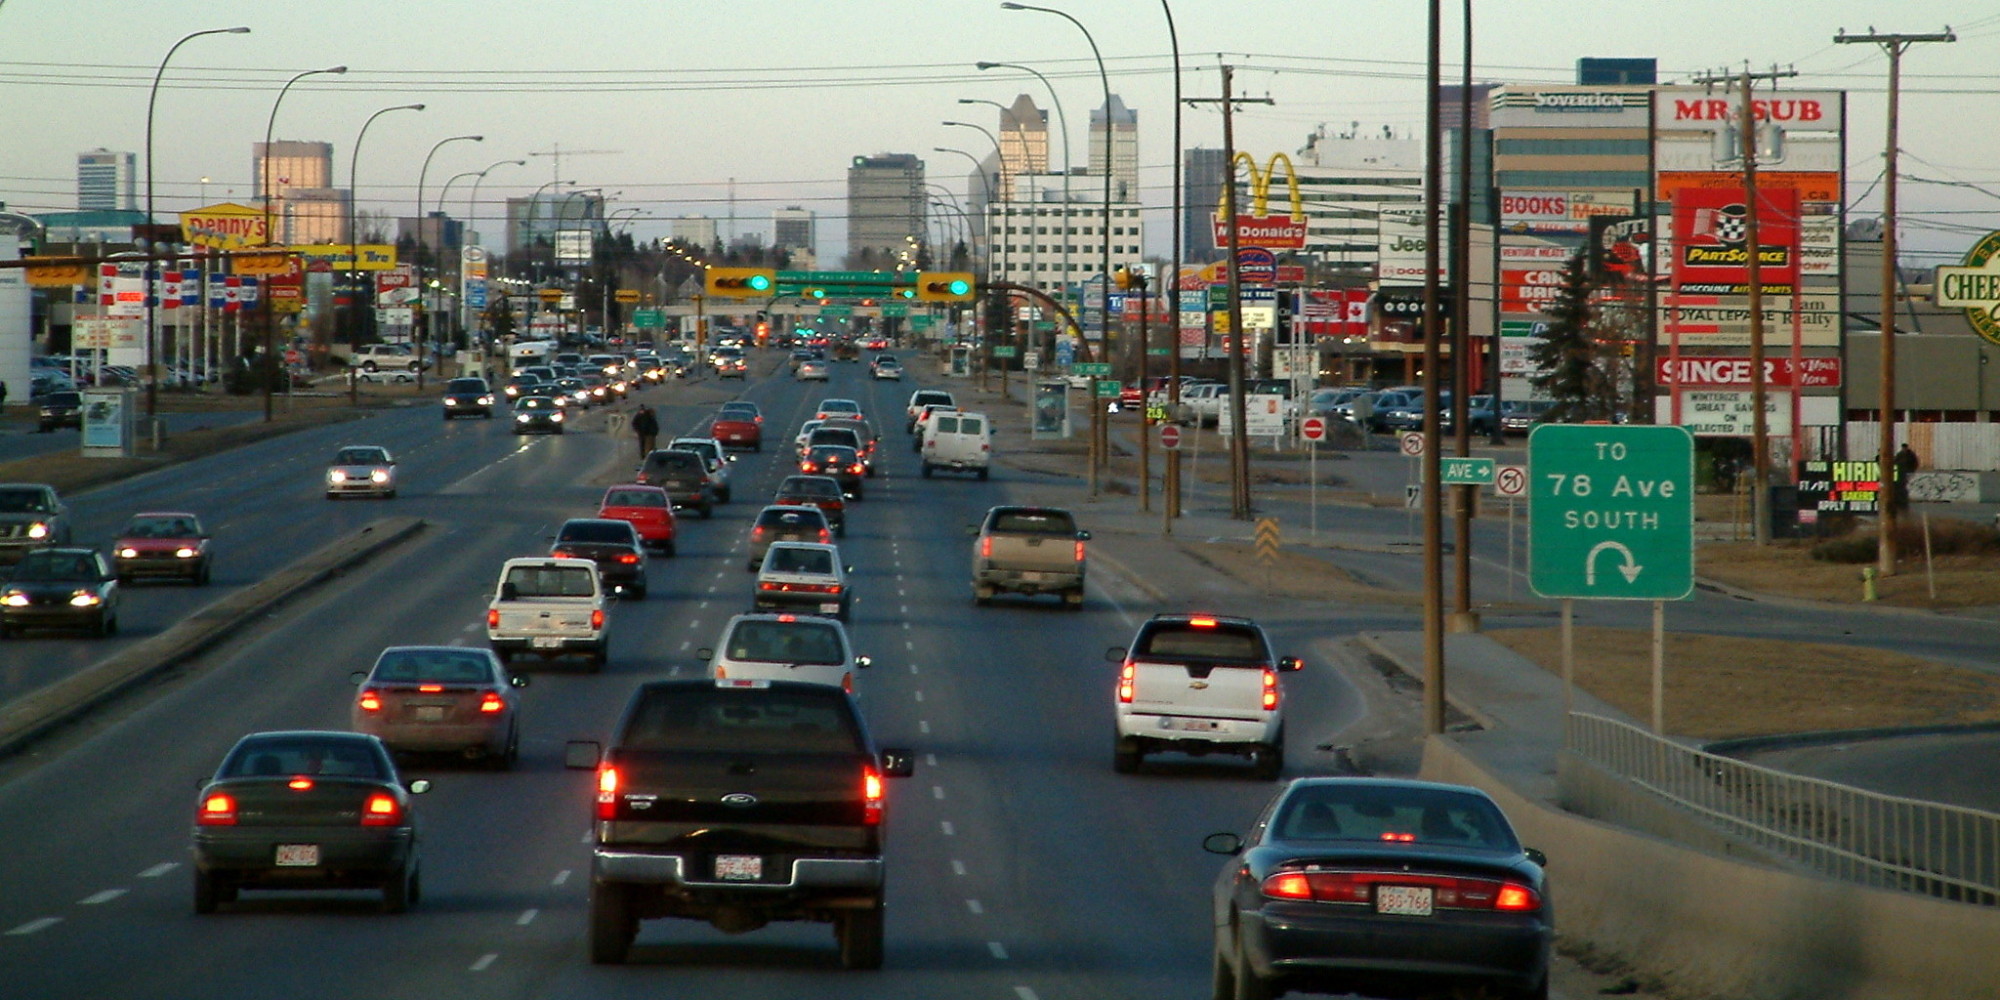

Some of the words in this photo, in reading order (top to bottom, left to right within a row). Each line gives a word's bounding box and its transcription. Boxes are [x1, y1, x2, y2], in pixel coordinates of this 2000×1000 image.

[1752, 100, 1823, 121] SUB
[1502, 196, 1565, 214] BOOKS
[189, 216, 267, 238] Denny's
[1217, 225, 1304, 238] MDonald's
[1390, 235, 1427, 252] Jee
[1783, 312, 1832, 328] Ralty
[1695, 403, 1726, 412] GREAT
[1724, 413, 1738, 422] ON
[1595, 442, 1627, 461] TO
[1447, 463, 1473, 479] AVE
[1547, 473, 1592, 497] 78
[1611, 475, 1676, 498] Ave
[1565, 510, 1659, 529] SOUTH
